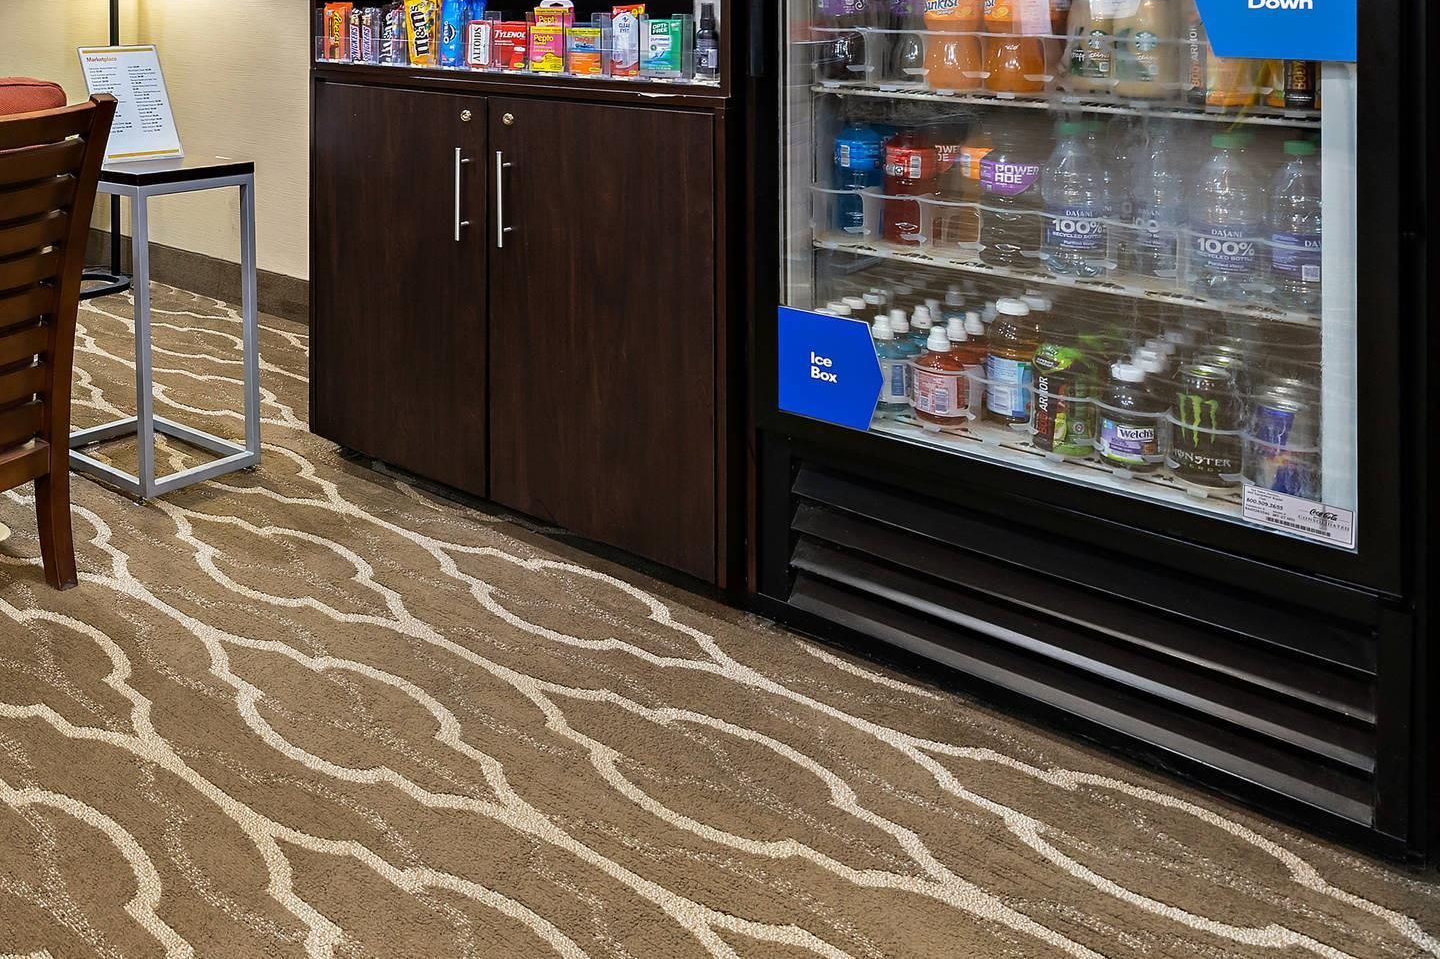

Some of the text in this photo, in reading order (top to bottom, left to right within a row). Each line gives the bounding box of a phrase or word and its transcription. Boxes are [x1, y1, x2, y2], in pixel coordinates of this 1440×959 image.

[494, 29, 526, 39] TYLENOL
[533, 34, 554, 43] Pepto
[350, 24, 360, 61] SNICKERS
[361, 24, 371, 61] SNICKERS
[472, 26, 481, 61] ALTOIDS
[1065, 209, 1094, 217] DASANI
[1052, 219, 1104, 234] 100%
[1210, 228, 1243, 238] DASANI
[1200, 238, 1256, 257] 100%
[810, 351, 832, 368] Ice
[810, 365, 837, 383] Box
[1119, 428, 1154, 441] Welch's
